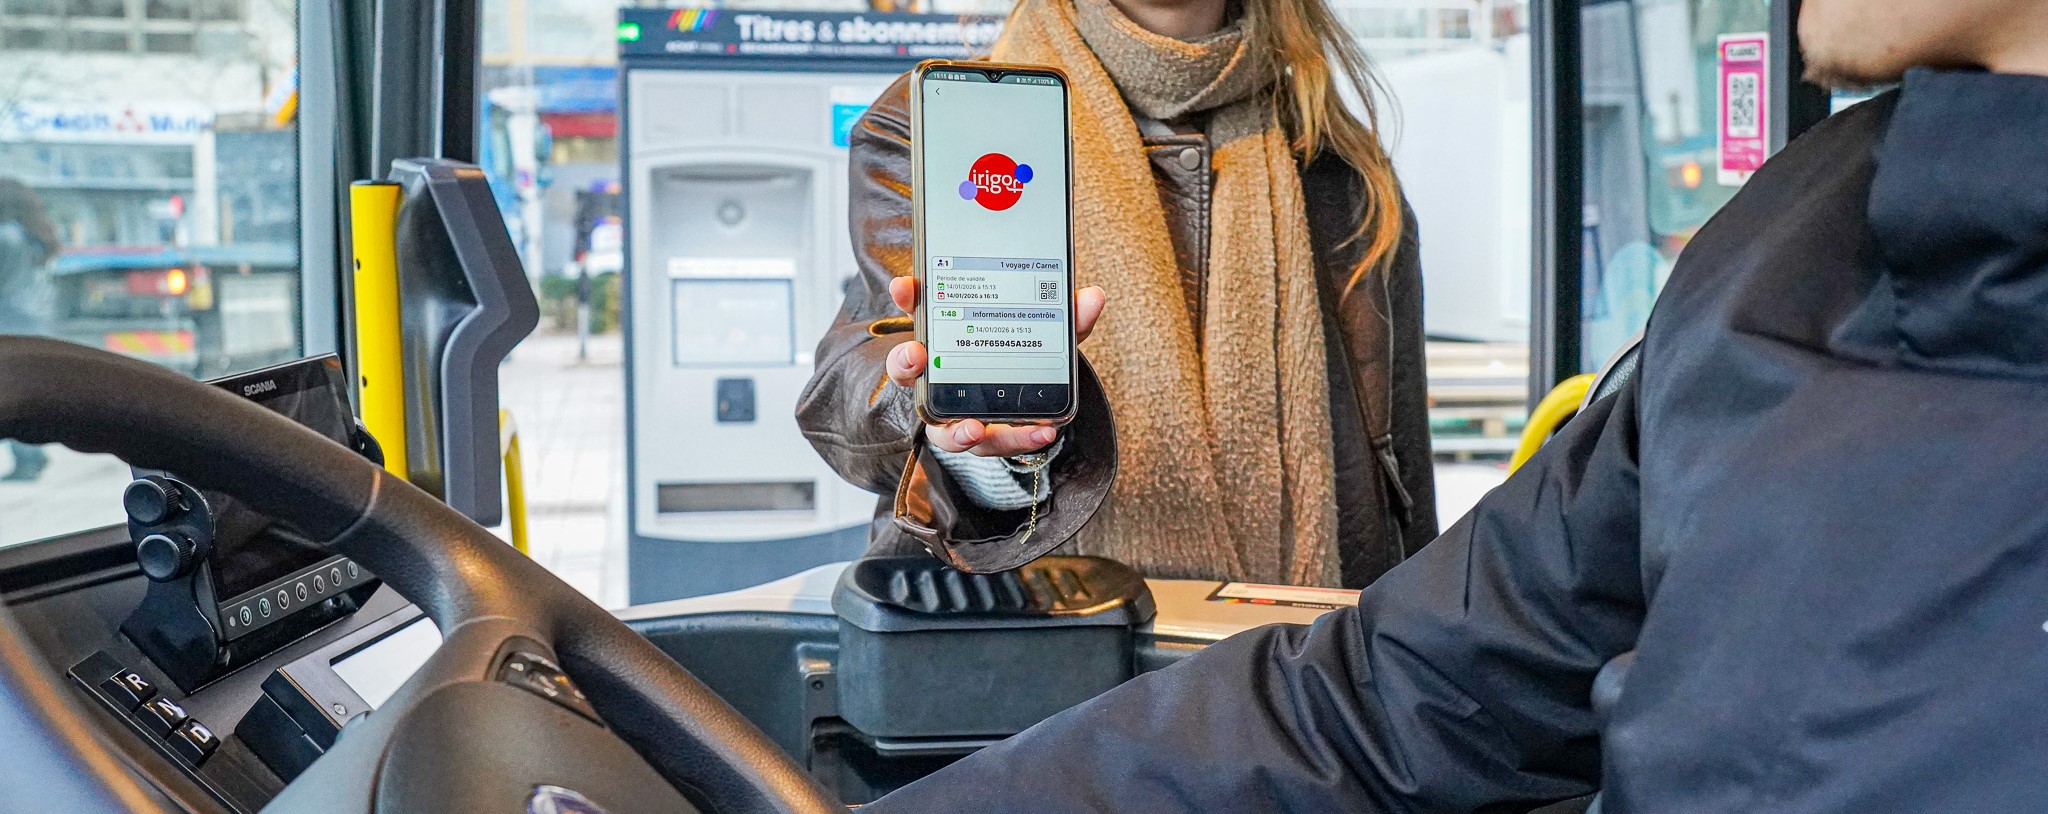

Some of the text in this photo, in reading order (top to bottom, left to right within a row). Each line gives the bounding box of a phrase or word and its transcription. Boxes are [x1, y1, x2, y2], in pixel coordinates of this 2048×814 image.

[735, 16, 815, 42] Titres
[1005, 262, 1030, 270] voyage
[1035, 262, 1059, 270] Carnet
[972, 311, 1016, 319] Informations
[1027, 311, 1056, 319] contrôle
[976, 326, 1010, 334] 14/01/2026
[956, 339, 1043, 348] 198-67F65945A3285
[243, 379, 277, 397] SCANIA
[126, 673, 149, 691] R
[157, 698, 188, 719] N
[190, 725, 210, 744] D
